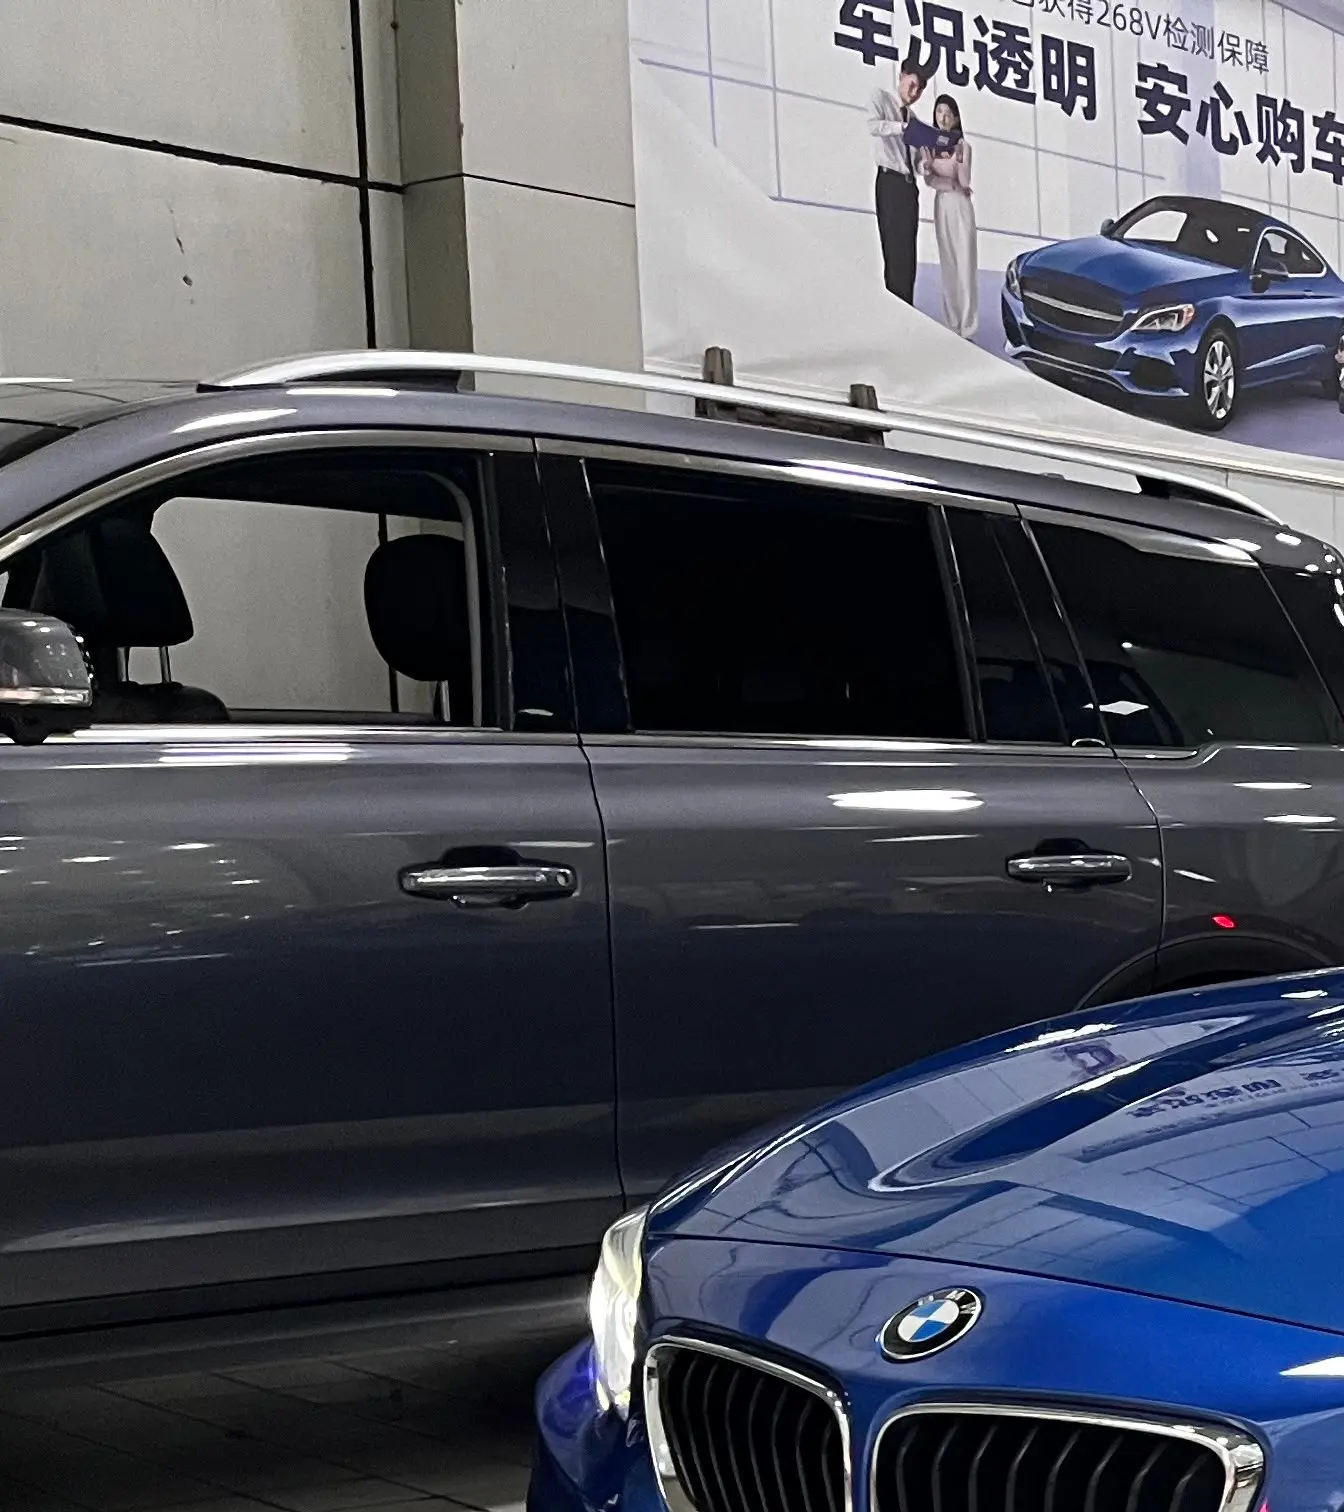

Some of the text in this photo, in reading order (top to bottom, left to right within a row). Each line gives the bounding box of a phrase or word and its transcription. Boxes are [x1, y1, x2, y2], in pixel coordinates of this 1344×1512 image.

[833, 0, 1097, 121] 车况透明
[1013, 0, 1269, 75] 得268V检测保障
